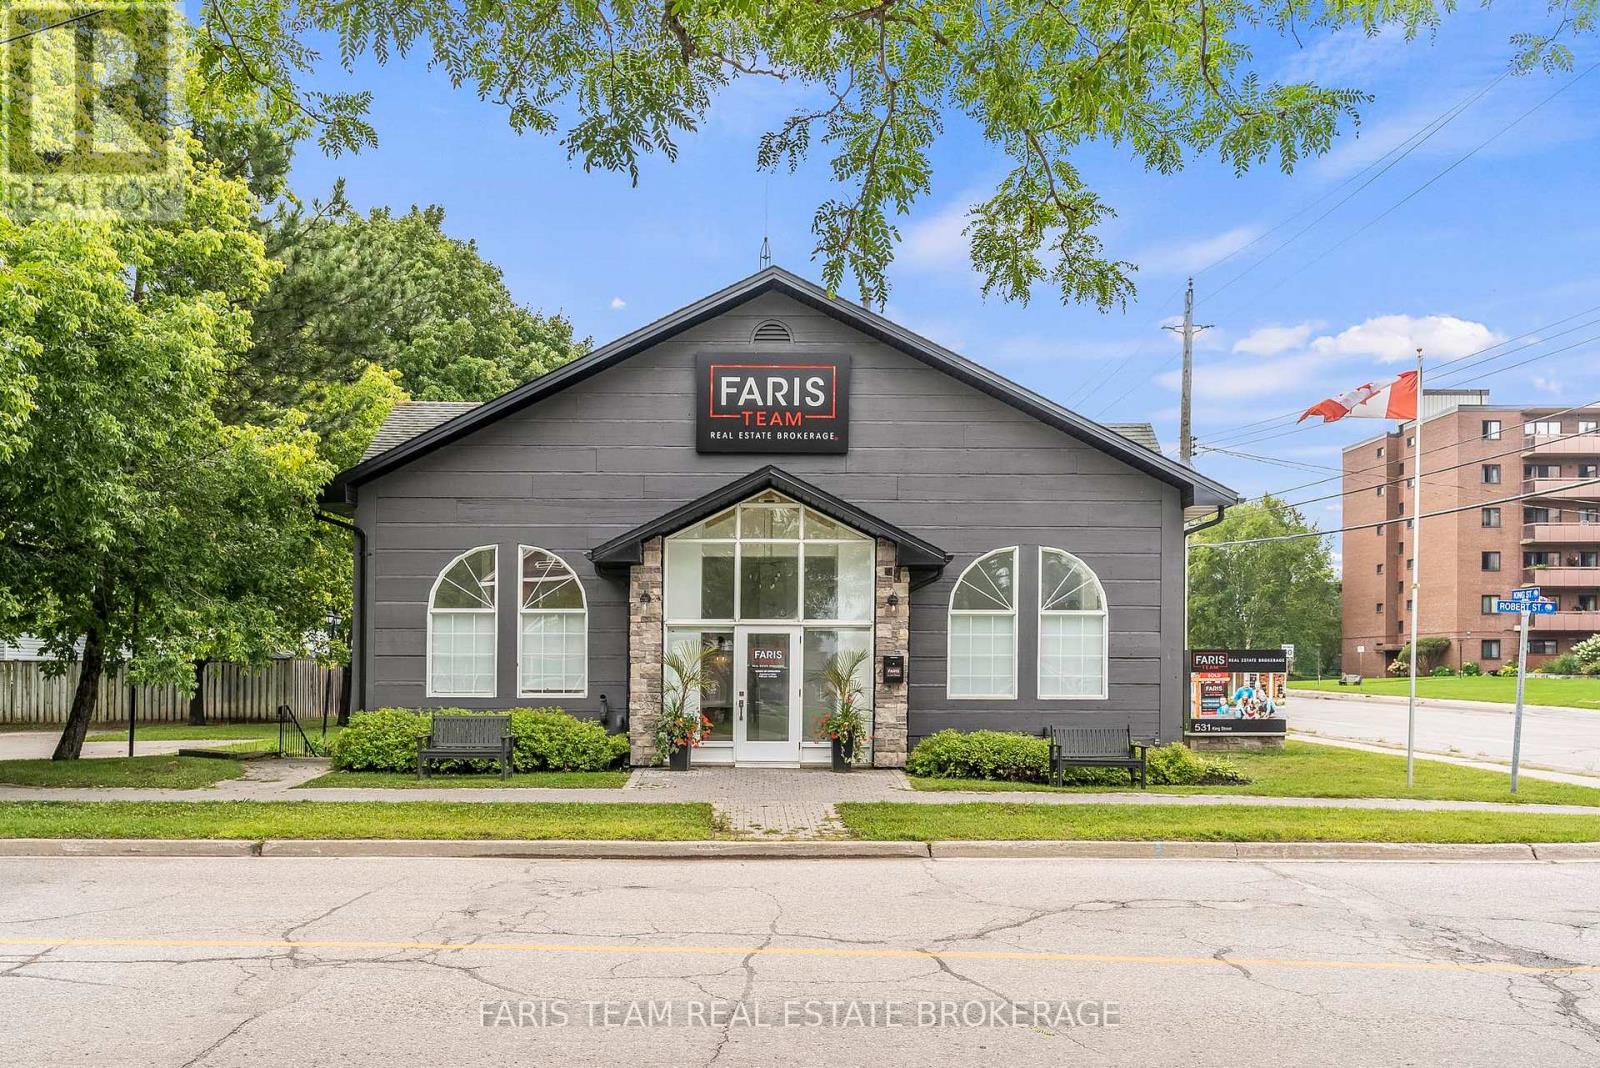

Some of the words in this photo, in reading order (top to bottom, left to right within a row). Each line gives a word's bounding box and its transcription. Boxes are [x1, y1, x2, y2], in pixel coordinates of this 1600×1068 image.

[720, 376, 825, 407] FARIS
[741, 411, 802, 426] TEAM
[710, 431, 734, 440] REAL
[738, 431, 772, 440] ESTATE
[777, 431, 835, 441] BROKERAGE
[1513, 591, 1525, 599] KING
[1500, 602, 1530, 611] ROBERT
[754, 650, 782, 659] FARIS
[1195, 655, 1225, 665] FARIS
[1194, 723, 1211, 732] 531
